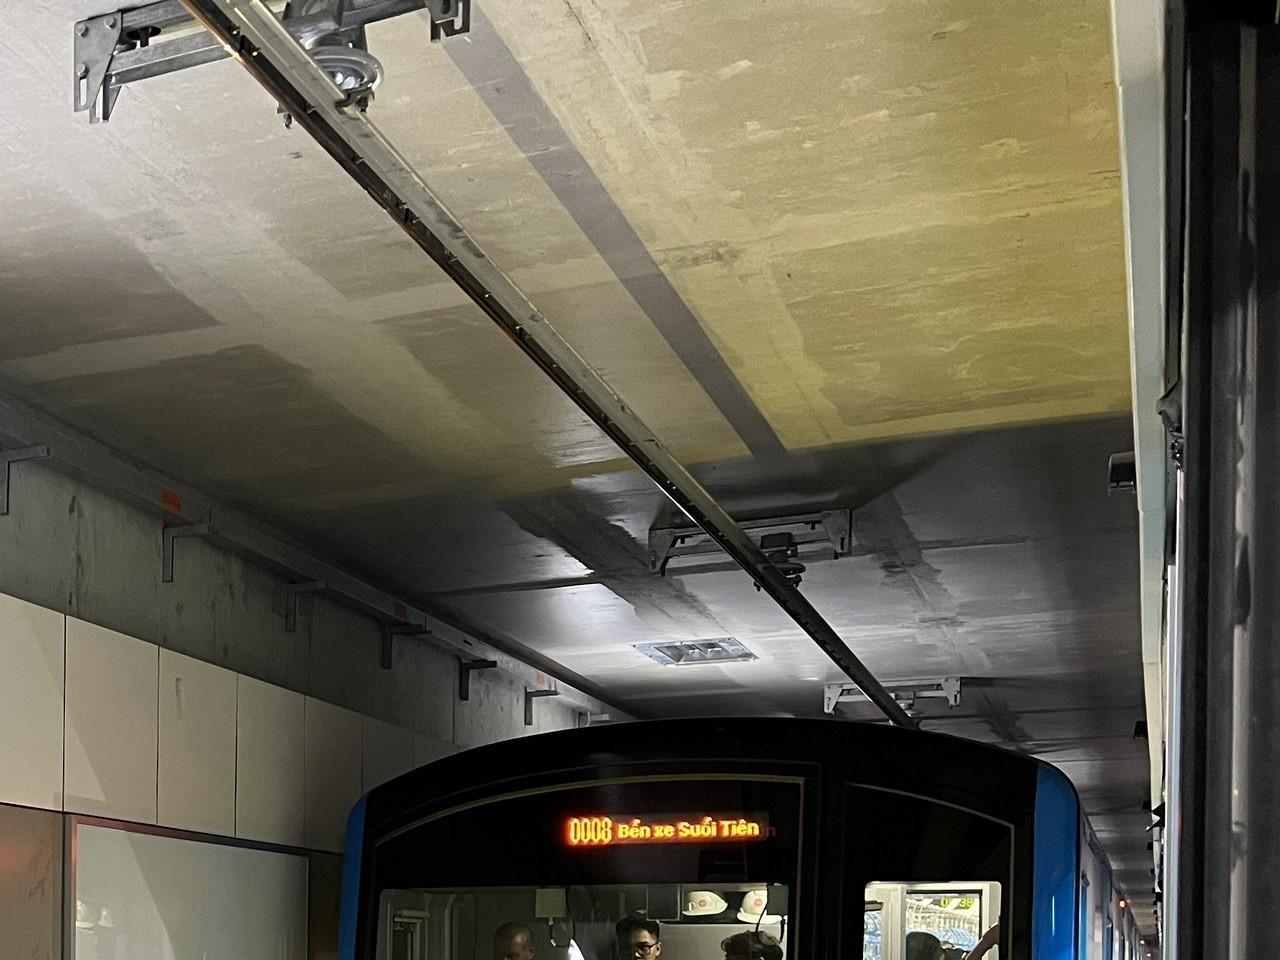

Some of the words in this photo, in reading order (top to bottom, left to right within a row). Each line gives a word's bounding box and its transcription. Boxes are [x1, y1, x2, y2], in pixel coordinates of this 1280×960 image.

[569, 817, 612, 845] 0008
[653, 824, 675, 838] xe
[719, 818, 760, 838] Tiên
